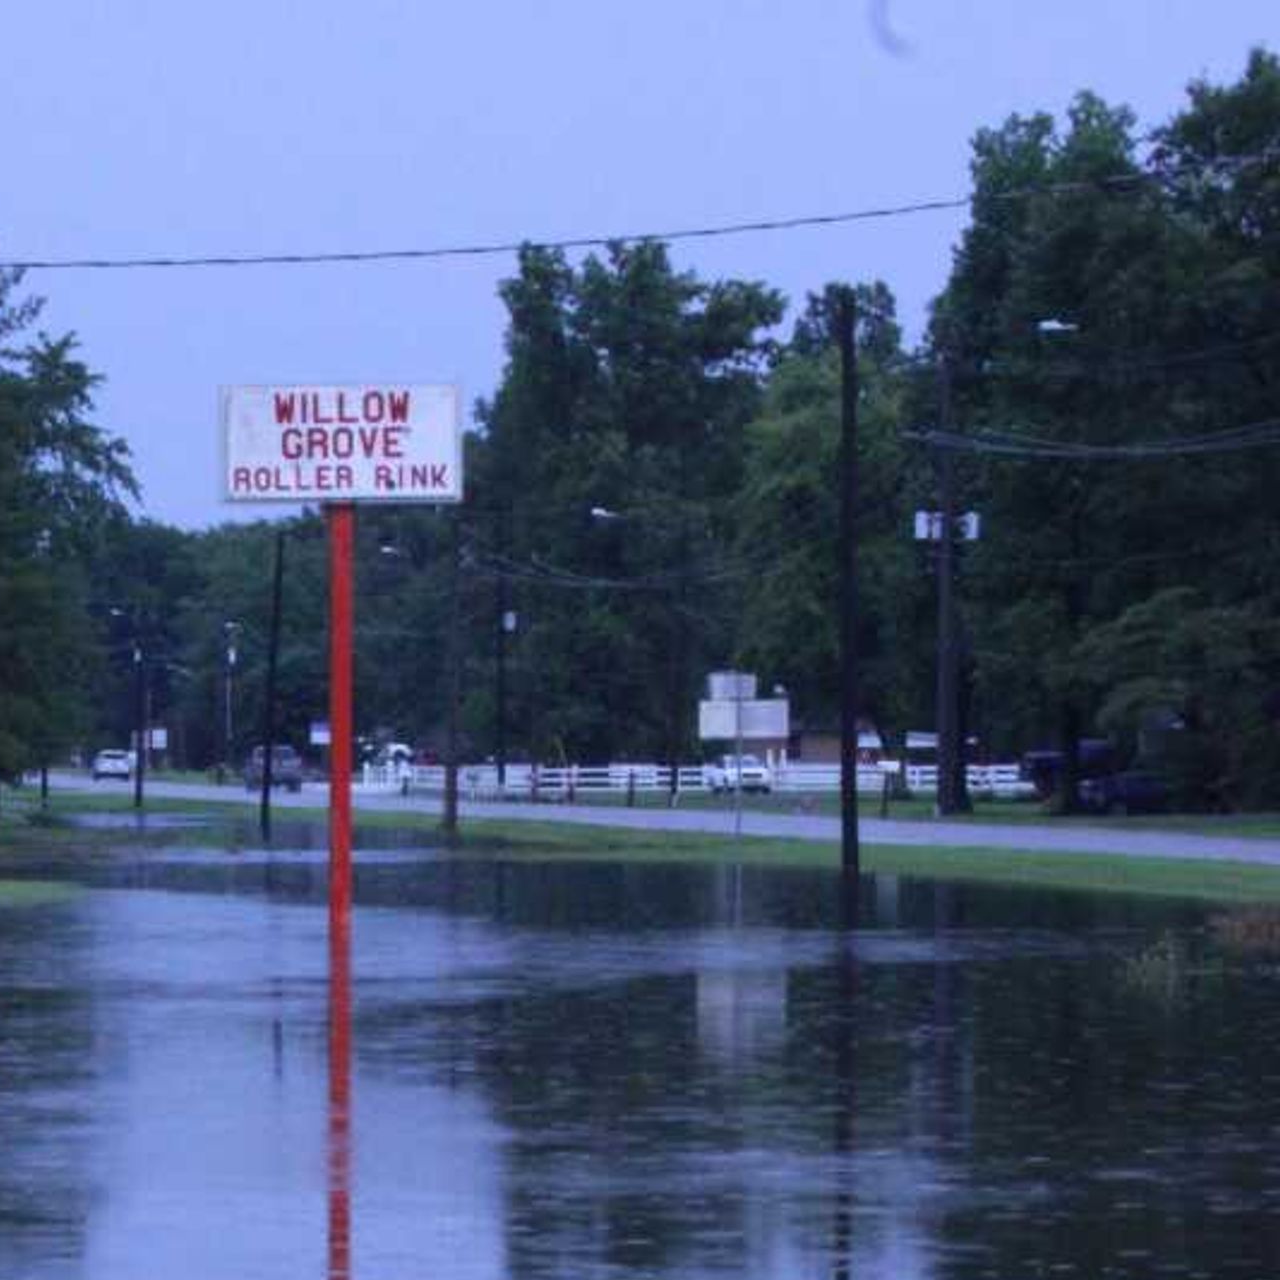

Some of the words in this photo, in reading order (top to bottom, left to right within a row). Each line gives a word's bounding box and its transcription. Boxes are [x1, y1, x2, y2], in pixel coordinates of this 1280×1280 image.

[274, 391, 410, 424] WILLOW
[281, 427, 407, 459] GROVE
[233, 464, 354, 492] ROLLER
[374, 464, 448, 490] RINK
